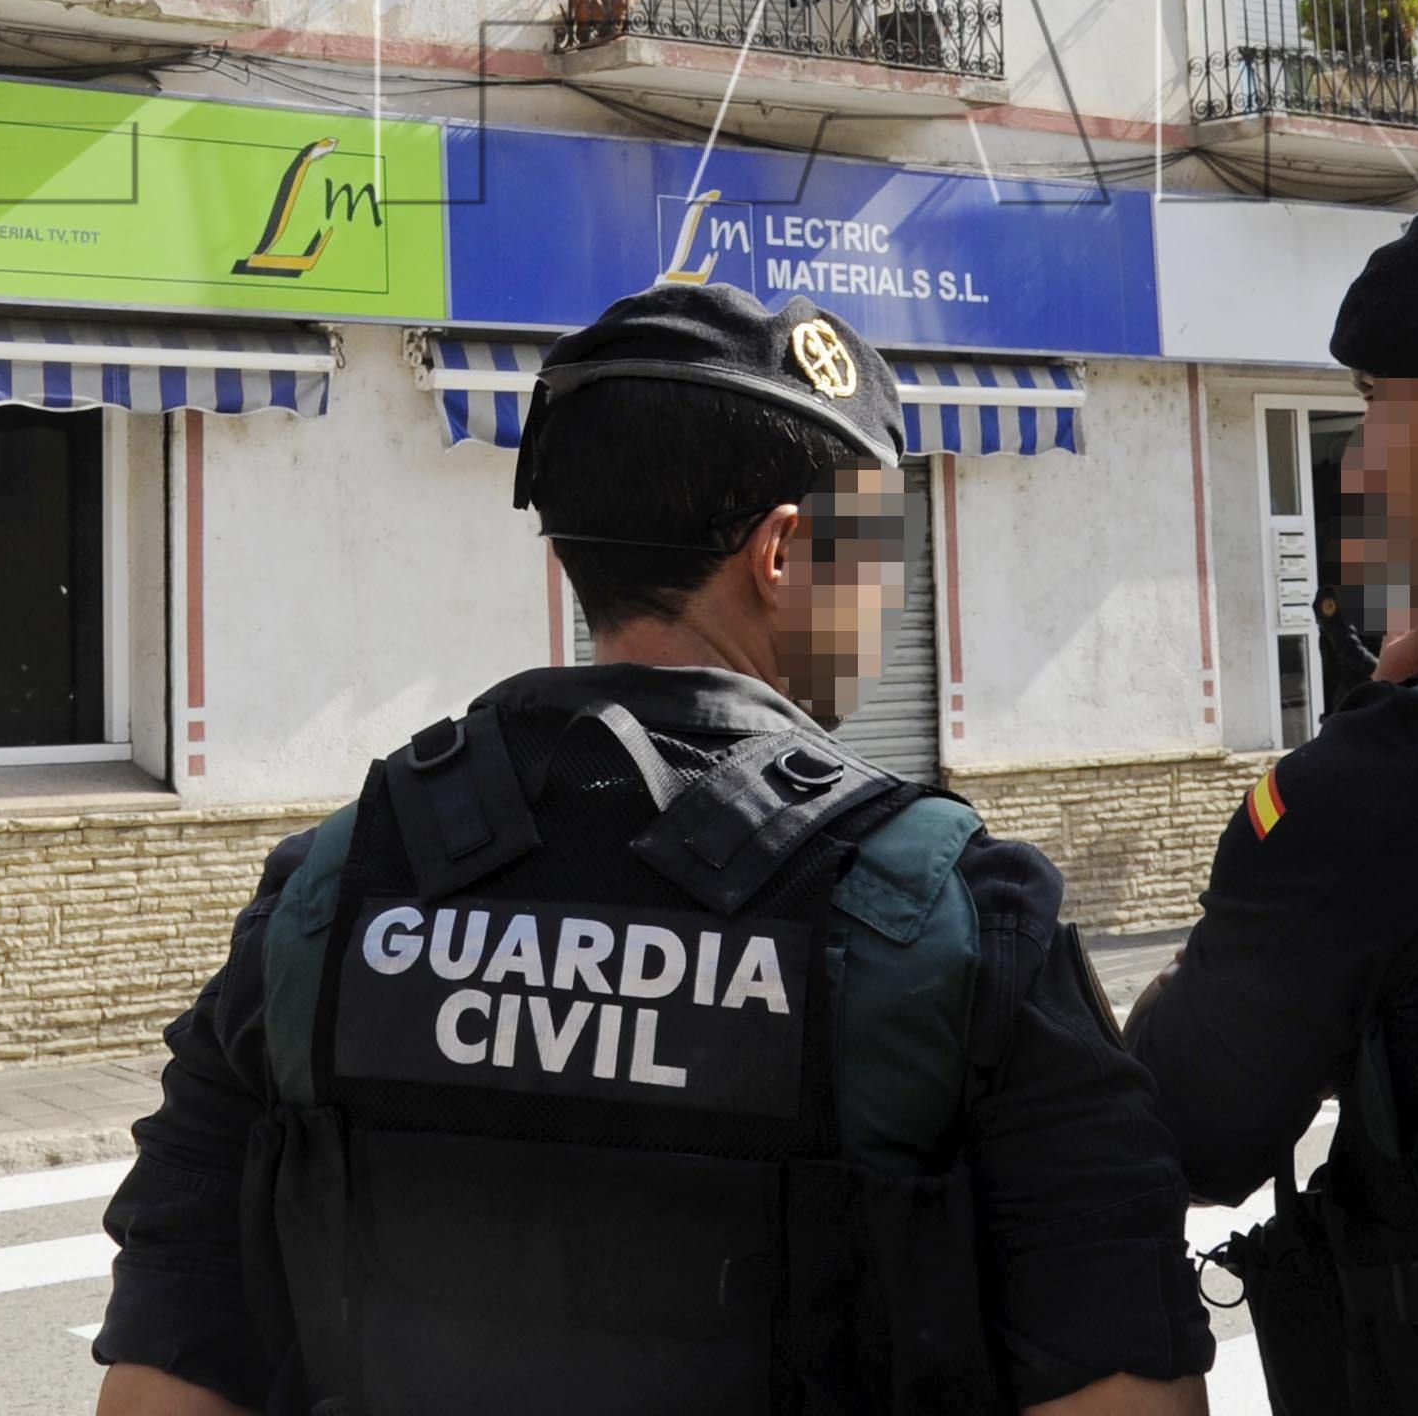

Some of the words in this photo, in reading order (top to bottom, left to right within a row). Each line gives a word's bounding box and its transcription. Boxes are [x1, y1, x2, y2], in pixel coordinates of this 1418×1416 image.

[765, 215, 890, 254] LECTRIC
[766, 259, 932, 299] MATERIALS
[938, 269, 990, 303] S.L.
[362, 906, 790, 1014] GUARDIA
[435, 989, 687, 1088] CIVIL
